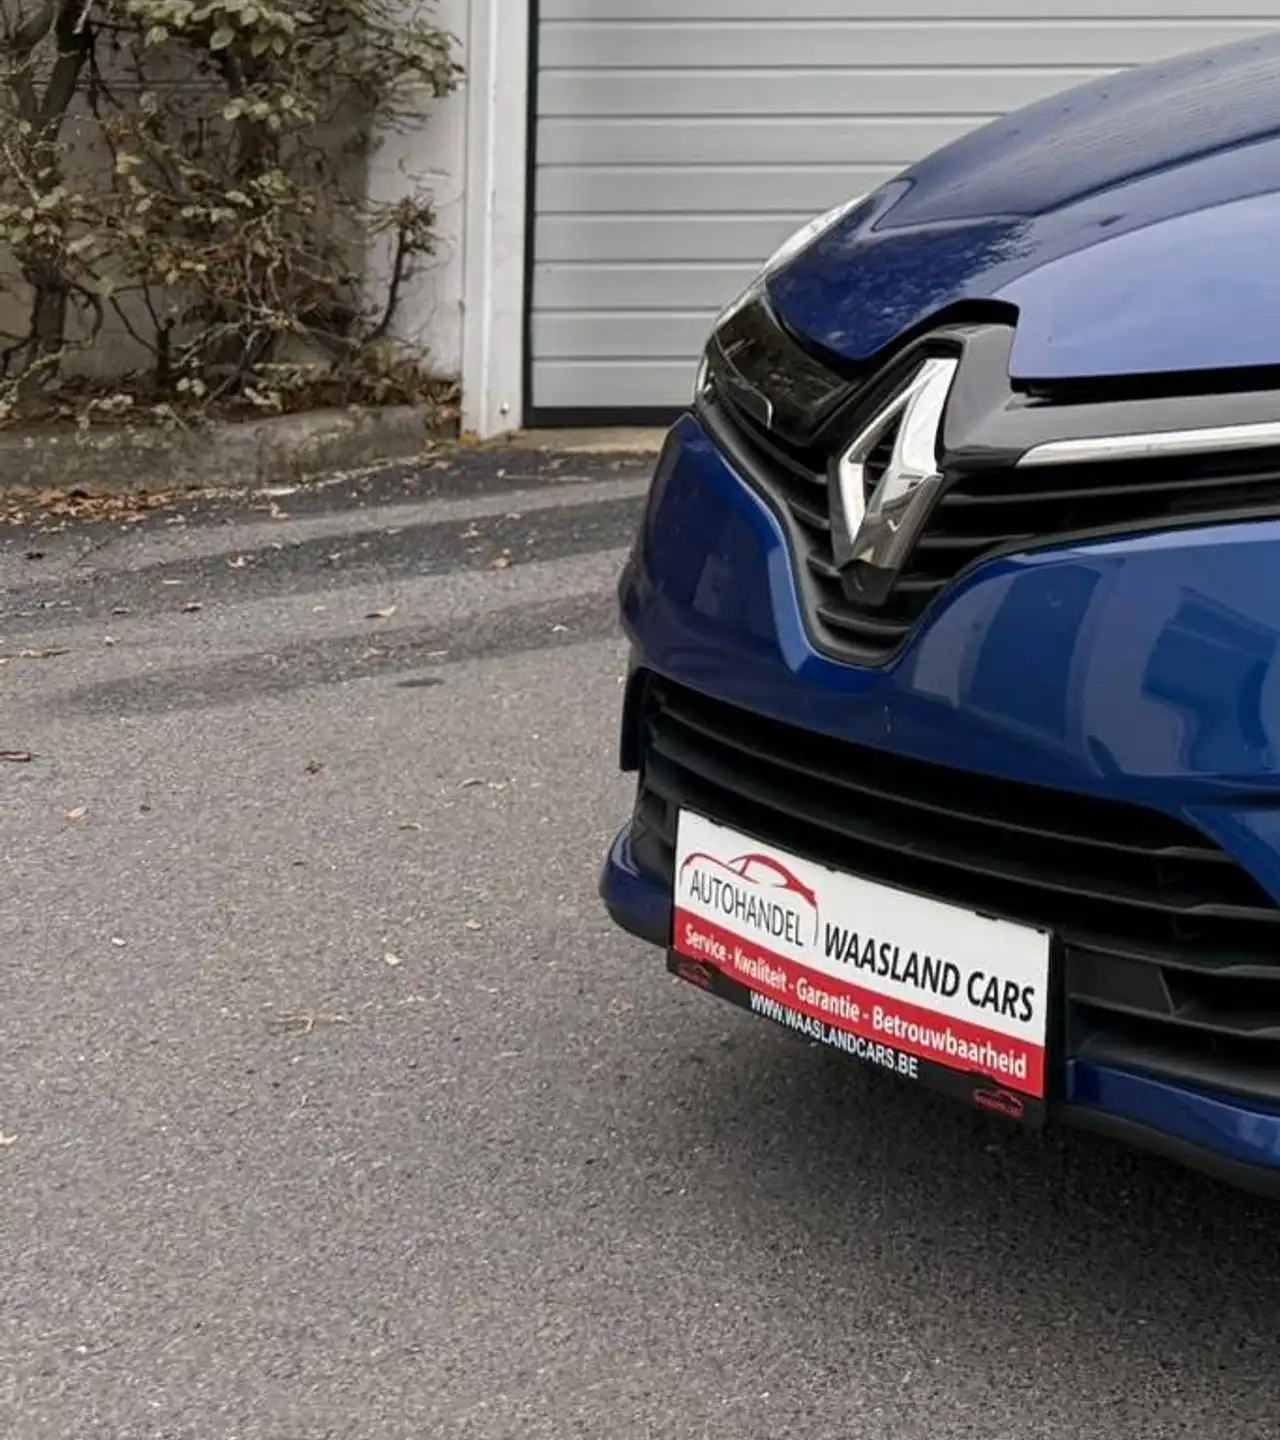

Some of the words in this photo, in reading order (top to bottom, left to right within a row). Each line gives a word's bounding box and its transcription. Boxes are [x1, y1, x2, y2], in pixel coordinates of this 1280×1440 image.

[689, 869, 804, 947] AUTOHANDEL
[684, 922, 726, 962] Service
[733, 946, 788, 993] Kwaliteit
[795, 977, 861, 1023] Garantie
[871, 1005, 1028, 1080] Betrouwbaarheid
[824, 922, 961, 998] WAASLAND
[966, 971, 1036, 1022] CARS
[749, 990, 919, 1080] WWW.WAASLANDCARS.BE
